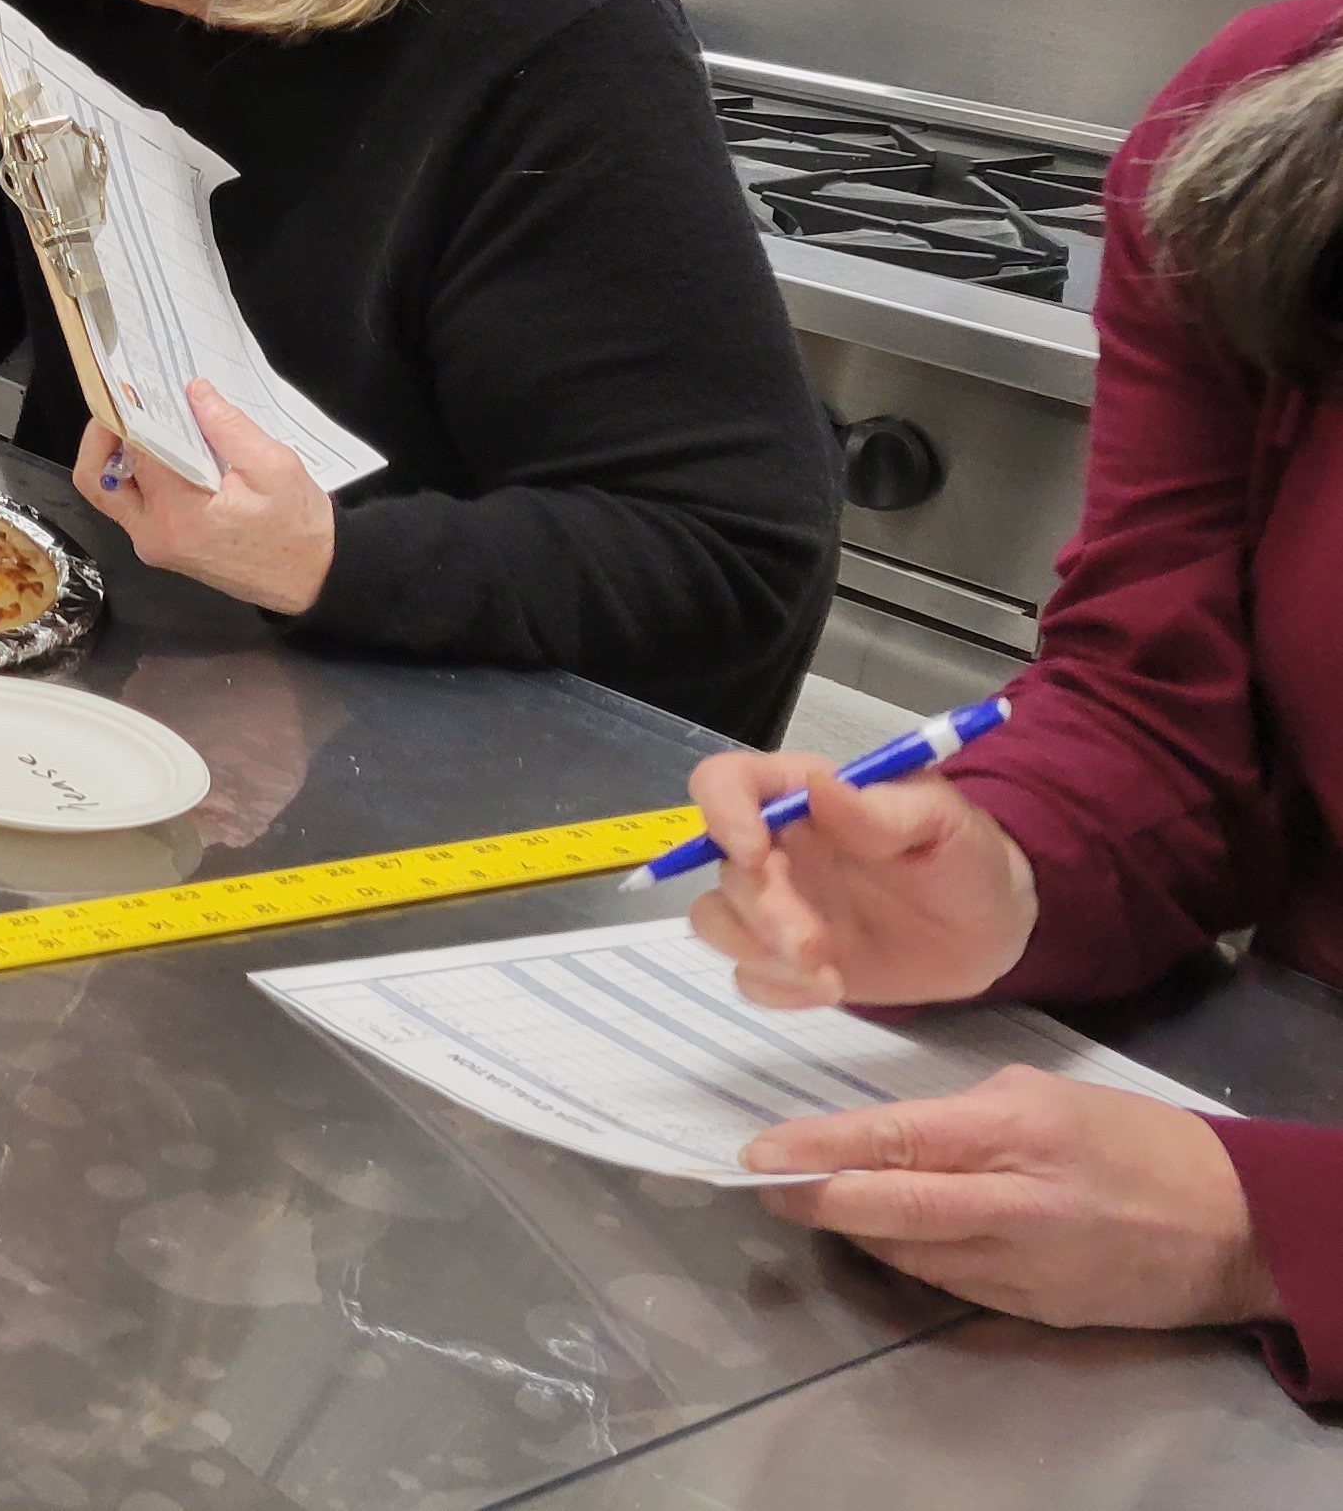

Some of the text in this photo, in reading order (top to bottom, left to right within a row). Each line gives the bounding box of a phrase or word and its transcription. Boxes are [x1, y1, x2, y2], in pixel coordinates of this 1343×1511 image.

[8, 914, 39, 927] 20
[64, 907, 88, 918] 21
[118, 897, 149, 909] 22
[170, 889, 201, 902] 23
[223, 881, 252, 893] 24
[274, 872, 305, 886] 25
[325, 865, 355, 877] 26
[376, 857, 402, 870] 27
[424, 849, 455, 862] 28
[472, 841, 503, 854] 29
[520, 833, 550, 847] 30
[567, 826, 592, 839] 31
[614, 820, 643, 832] 32
[659, 812, 688, 825] 33
